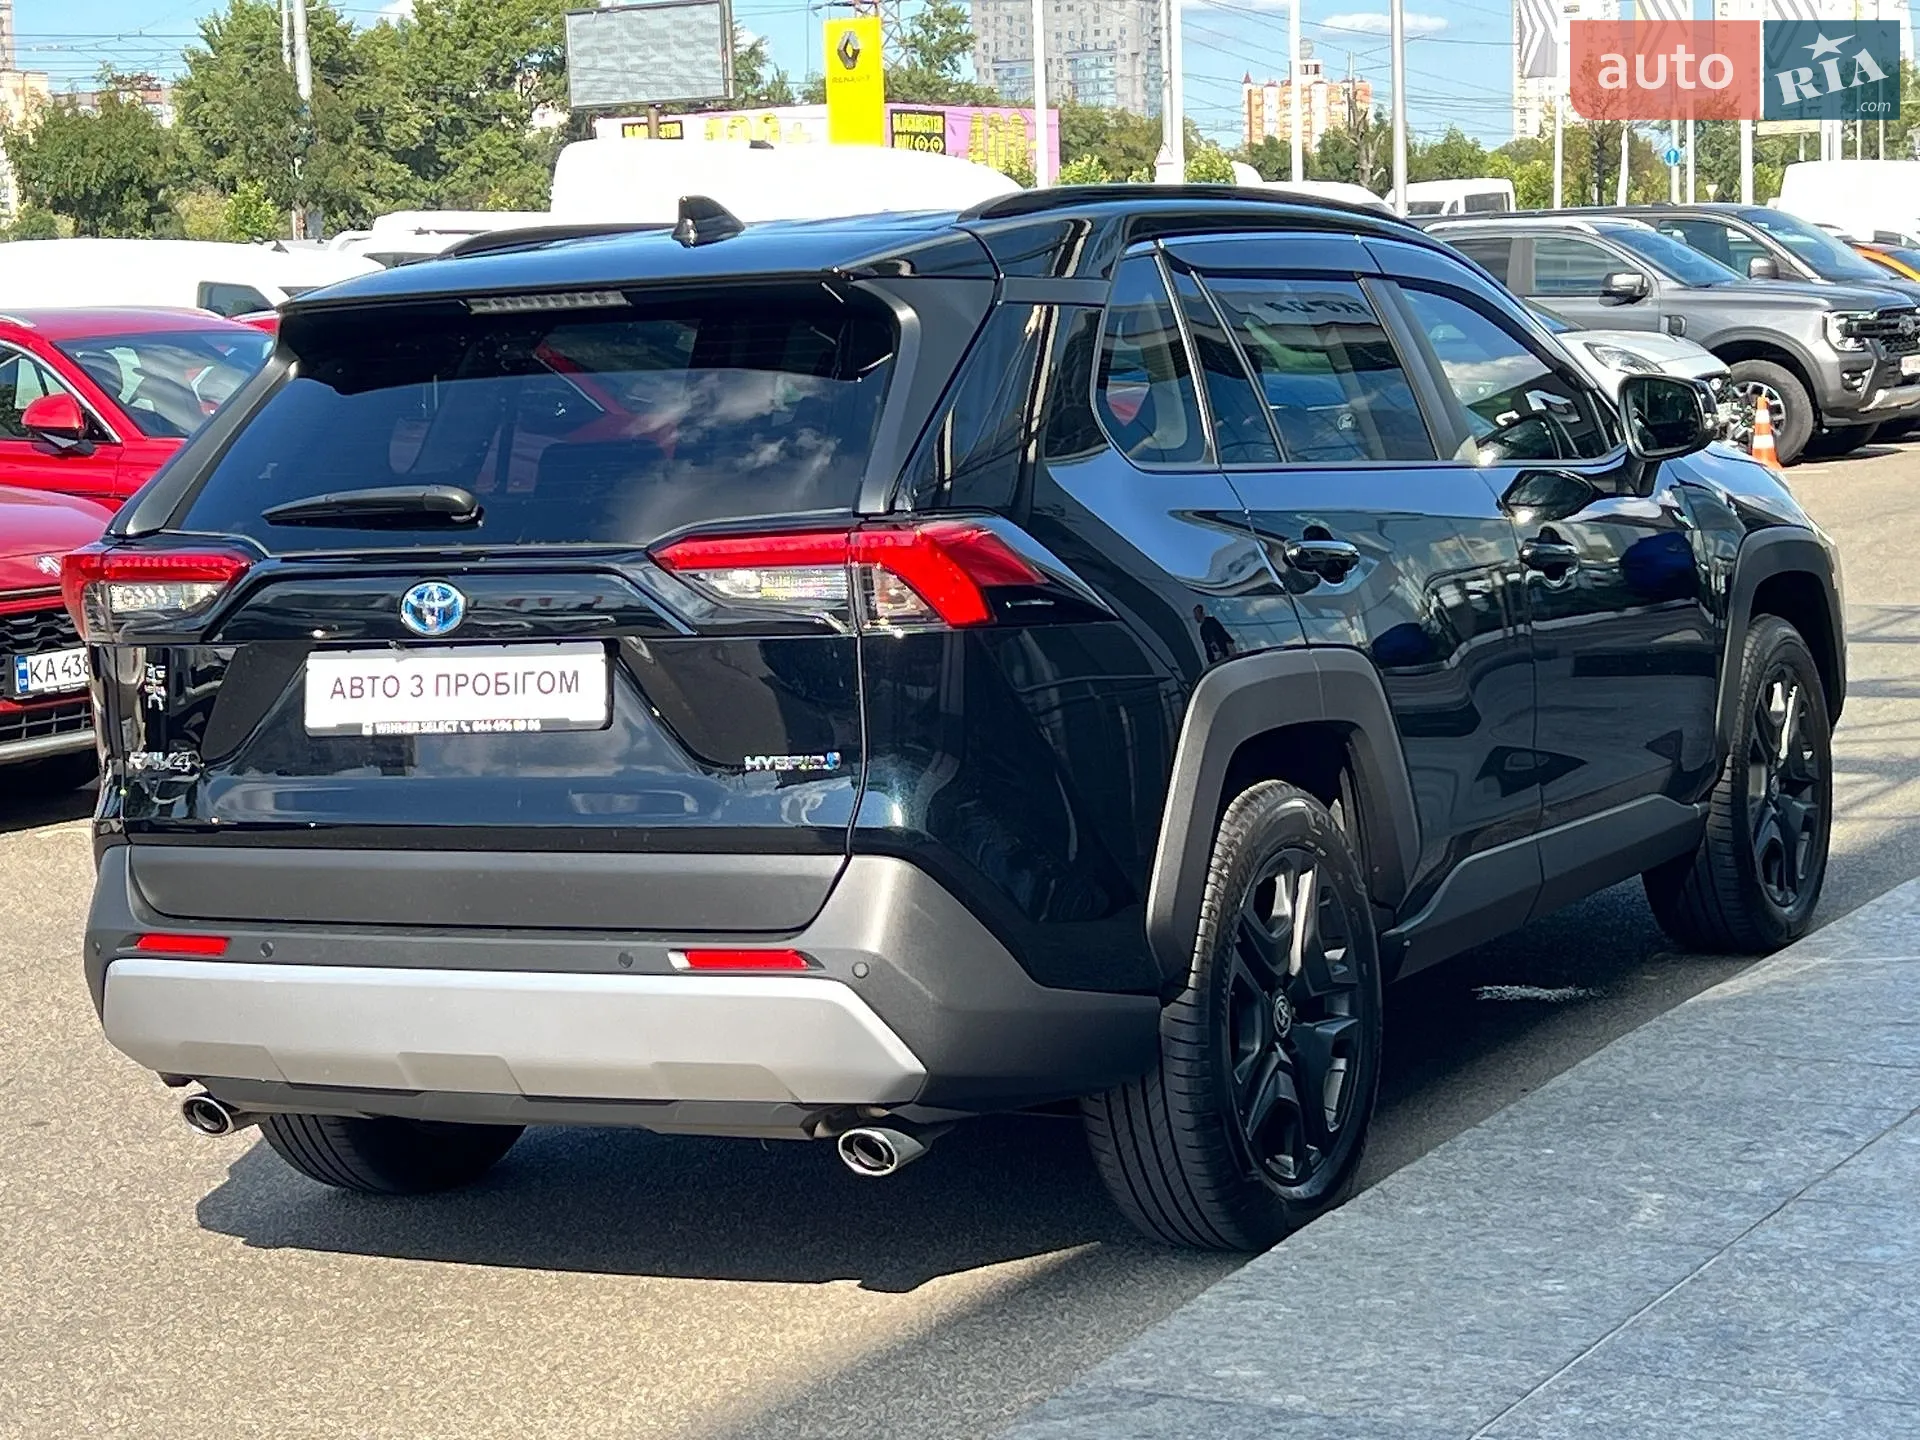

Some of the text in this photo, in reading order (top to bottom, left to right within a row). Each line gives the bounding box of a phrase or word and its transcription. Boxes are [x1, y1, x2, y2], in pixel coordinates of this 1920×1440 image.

[29, 657, 58, 684] KA
[330, 675, 401, 700] АВТО
[435, 670, 580, 697] ПРОБІГОМ
